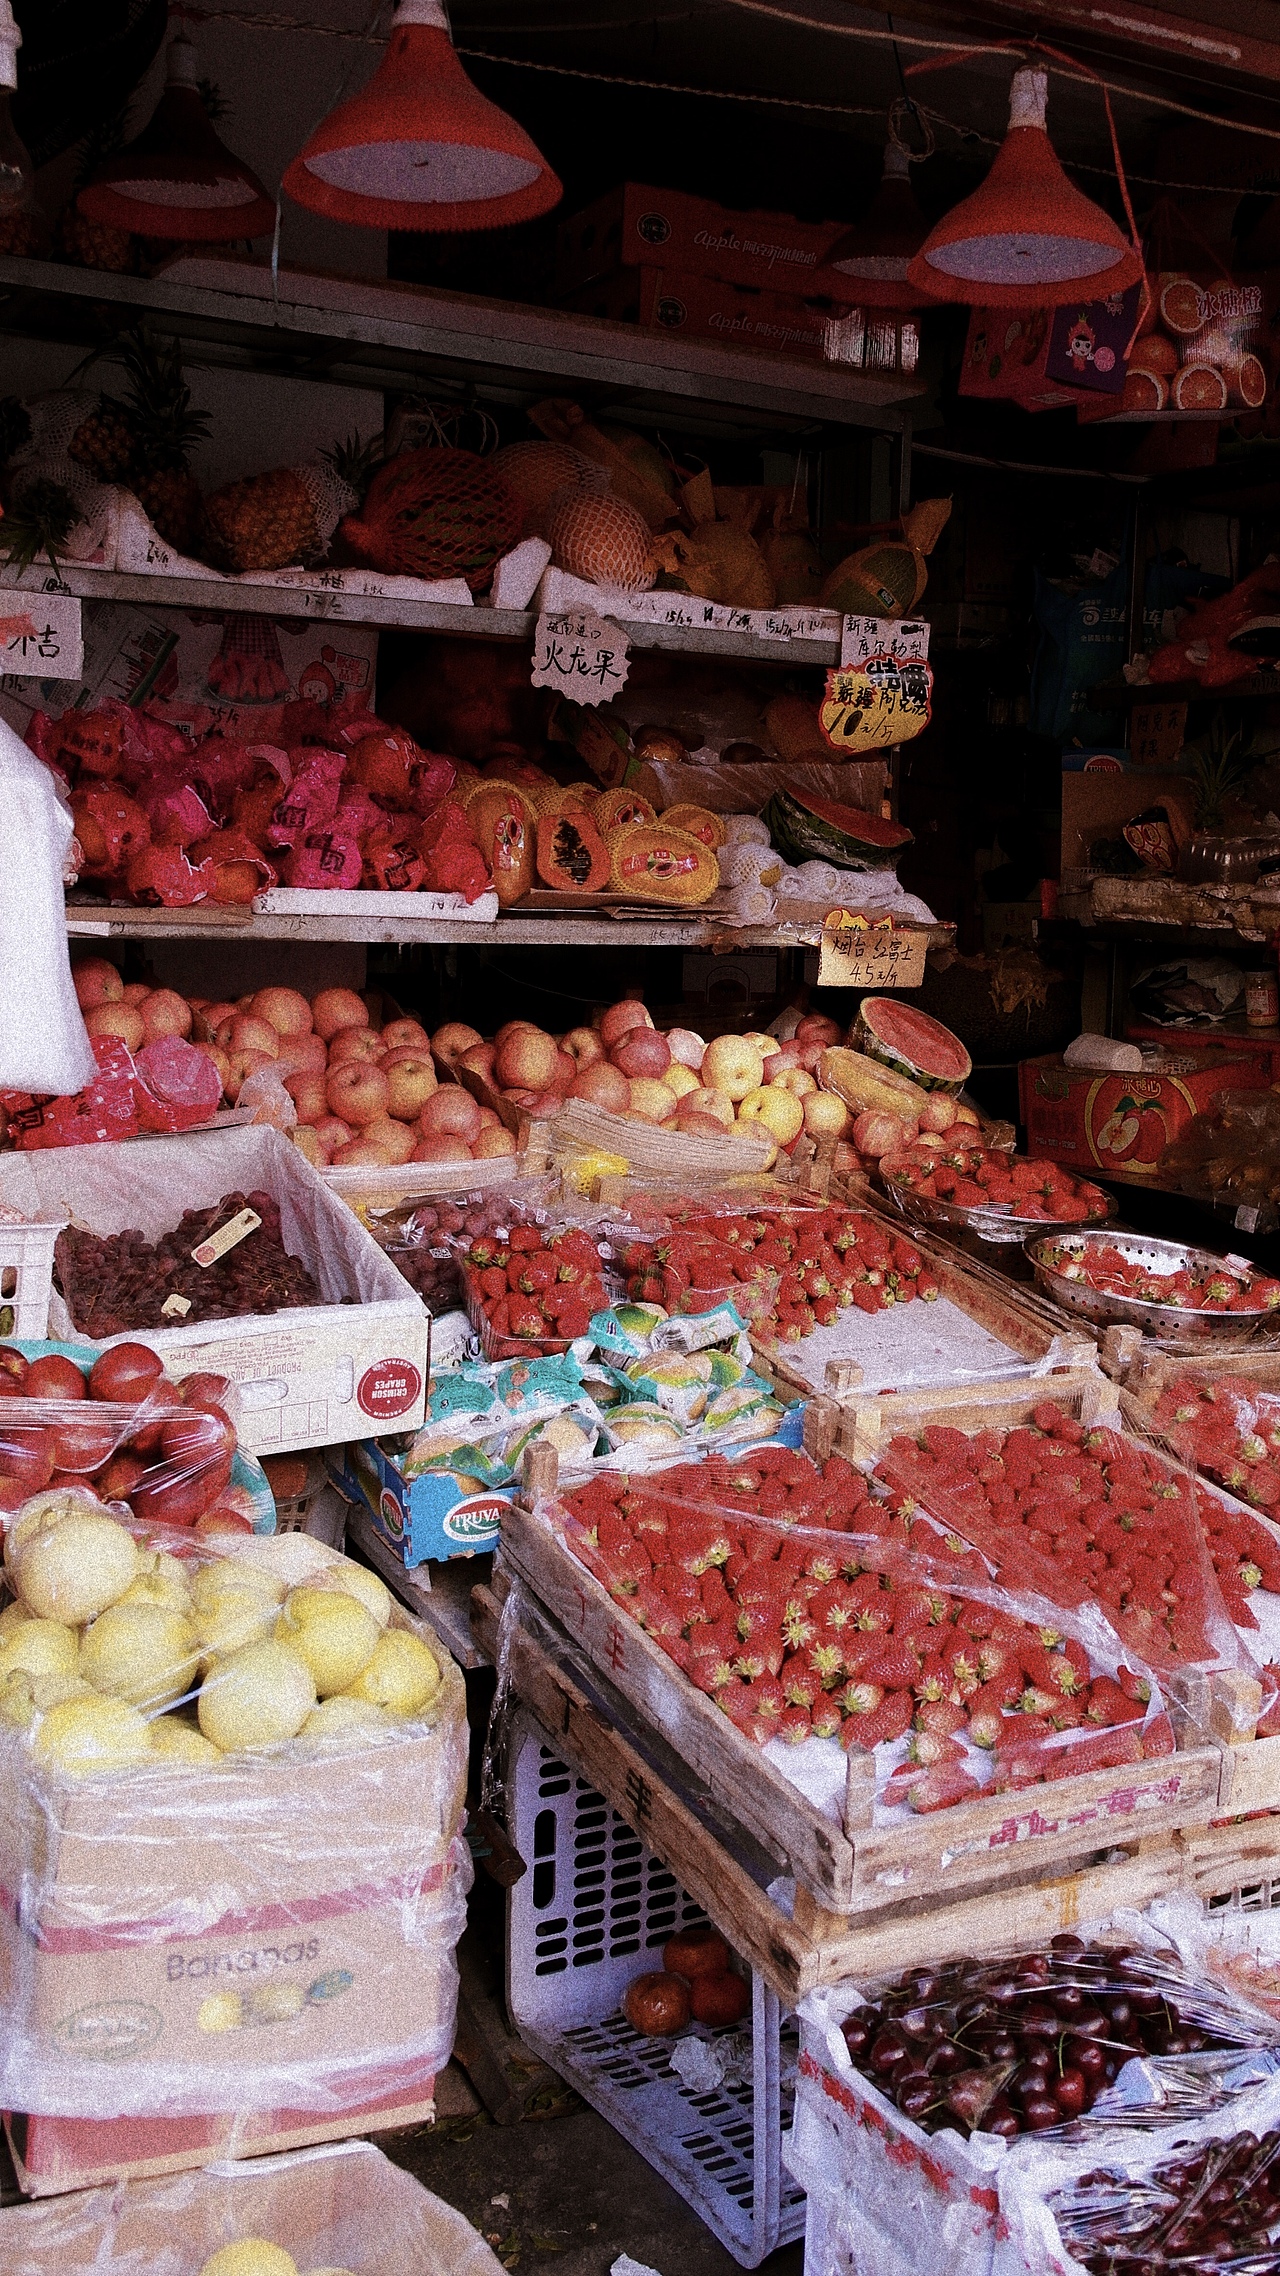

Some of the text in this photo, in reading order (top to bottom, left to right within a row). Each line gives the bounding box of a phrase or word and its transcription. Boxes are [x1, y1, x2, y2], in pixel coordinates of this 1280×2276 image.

[694, 229, 741, 251] Apple
[709, 311, 753, 333] Apple
[846, 616, 879, 636] 新疆
[540, 640, 622, 686] 火龙果
[253, 1367, 262, 1379] OF
[269, 1361, 302, 1377] PRODUCT
[374, 1379, 407, 1389] GRAPES
[371, 1388, 408, 1399] CRIMSON
[373, 1408, 403, 1417] PREMIUM
[166, 1937, 320, 1982] Bananas
